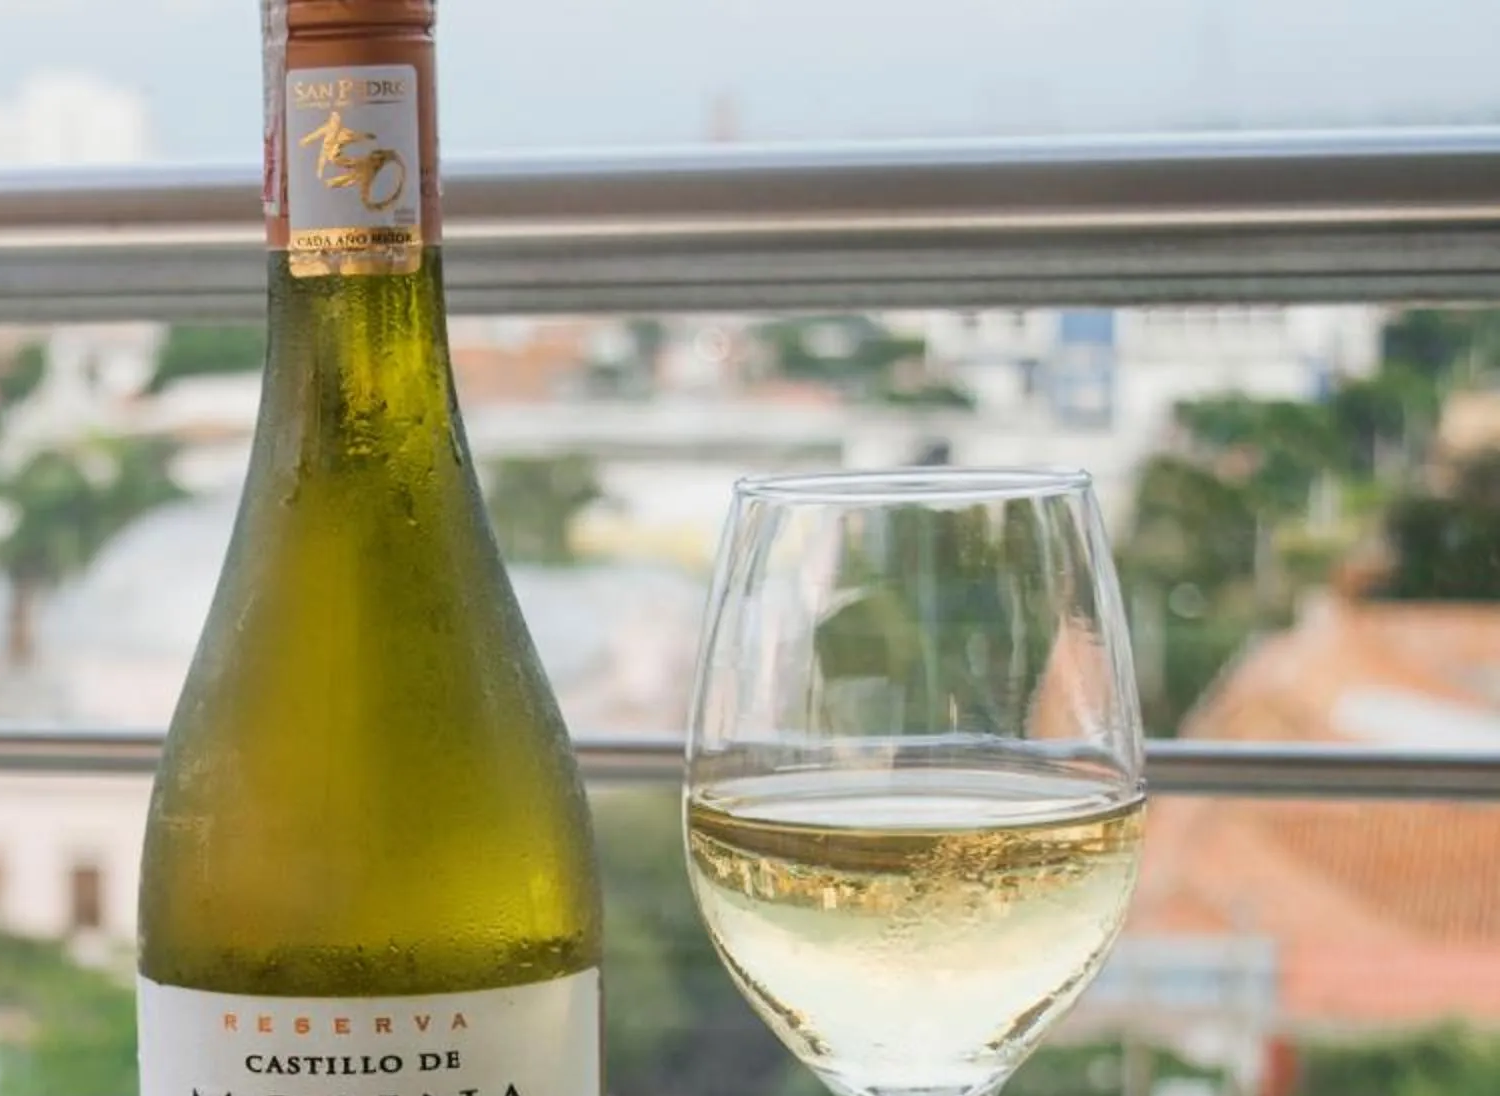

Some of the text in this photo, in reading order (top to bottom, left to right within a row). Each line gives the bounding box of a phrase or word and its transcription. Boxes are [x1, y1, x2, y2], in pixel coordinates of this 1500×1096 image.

[293, 79, 406, 101] SAN PDRO
[298, 234, 331, 247] CADA
[223, 1013, 468, 1034] RESERVA
[245, 1051, 461, 1075] CASTILLO DE
